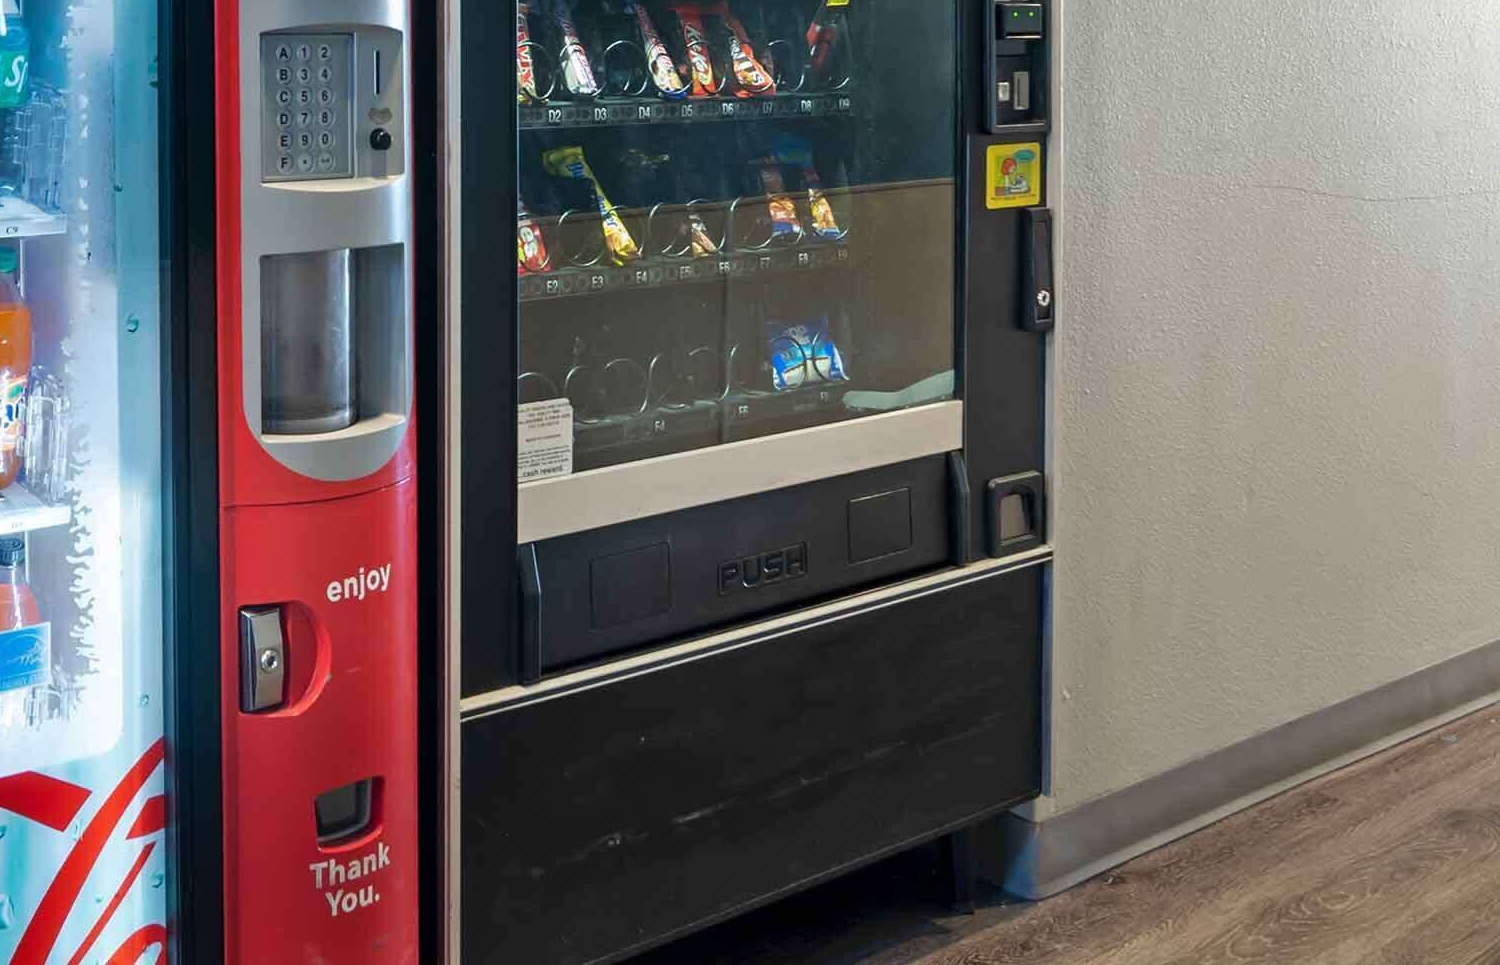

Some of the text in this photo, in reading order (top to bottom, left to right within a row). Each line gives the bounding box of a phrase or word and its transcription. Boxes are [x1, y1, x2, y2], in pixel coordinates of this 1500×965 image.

[280, 47, 328, 59] A 1 2
[280, 68, 328, 81] B 3 4
[280, 90, 328, 102] C 5 6
[280, 112, 328, 125] D 7 8
[548, 109, 562, 123] D2
[594, 108, 607, 121] D3
[638, 106, 651, 119] D4
[722, 102, 734, 115] D6
[281, 133, 328, 147] E 9 0
[281, 157, 288, 169] F
[6, 226, 18, 235] C9
[547, 280, 558, 293] E2
[592, 276, 603, 289] E3
[636, 271, 647, 283] E4
[680, 266, 691, 278] E5
[720, 544, 804, 590] PUSH
[326, 563, 391, 603] enjoy
[309, 842, 391, 889] Thank
[325, 884, 380, 917] You.
